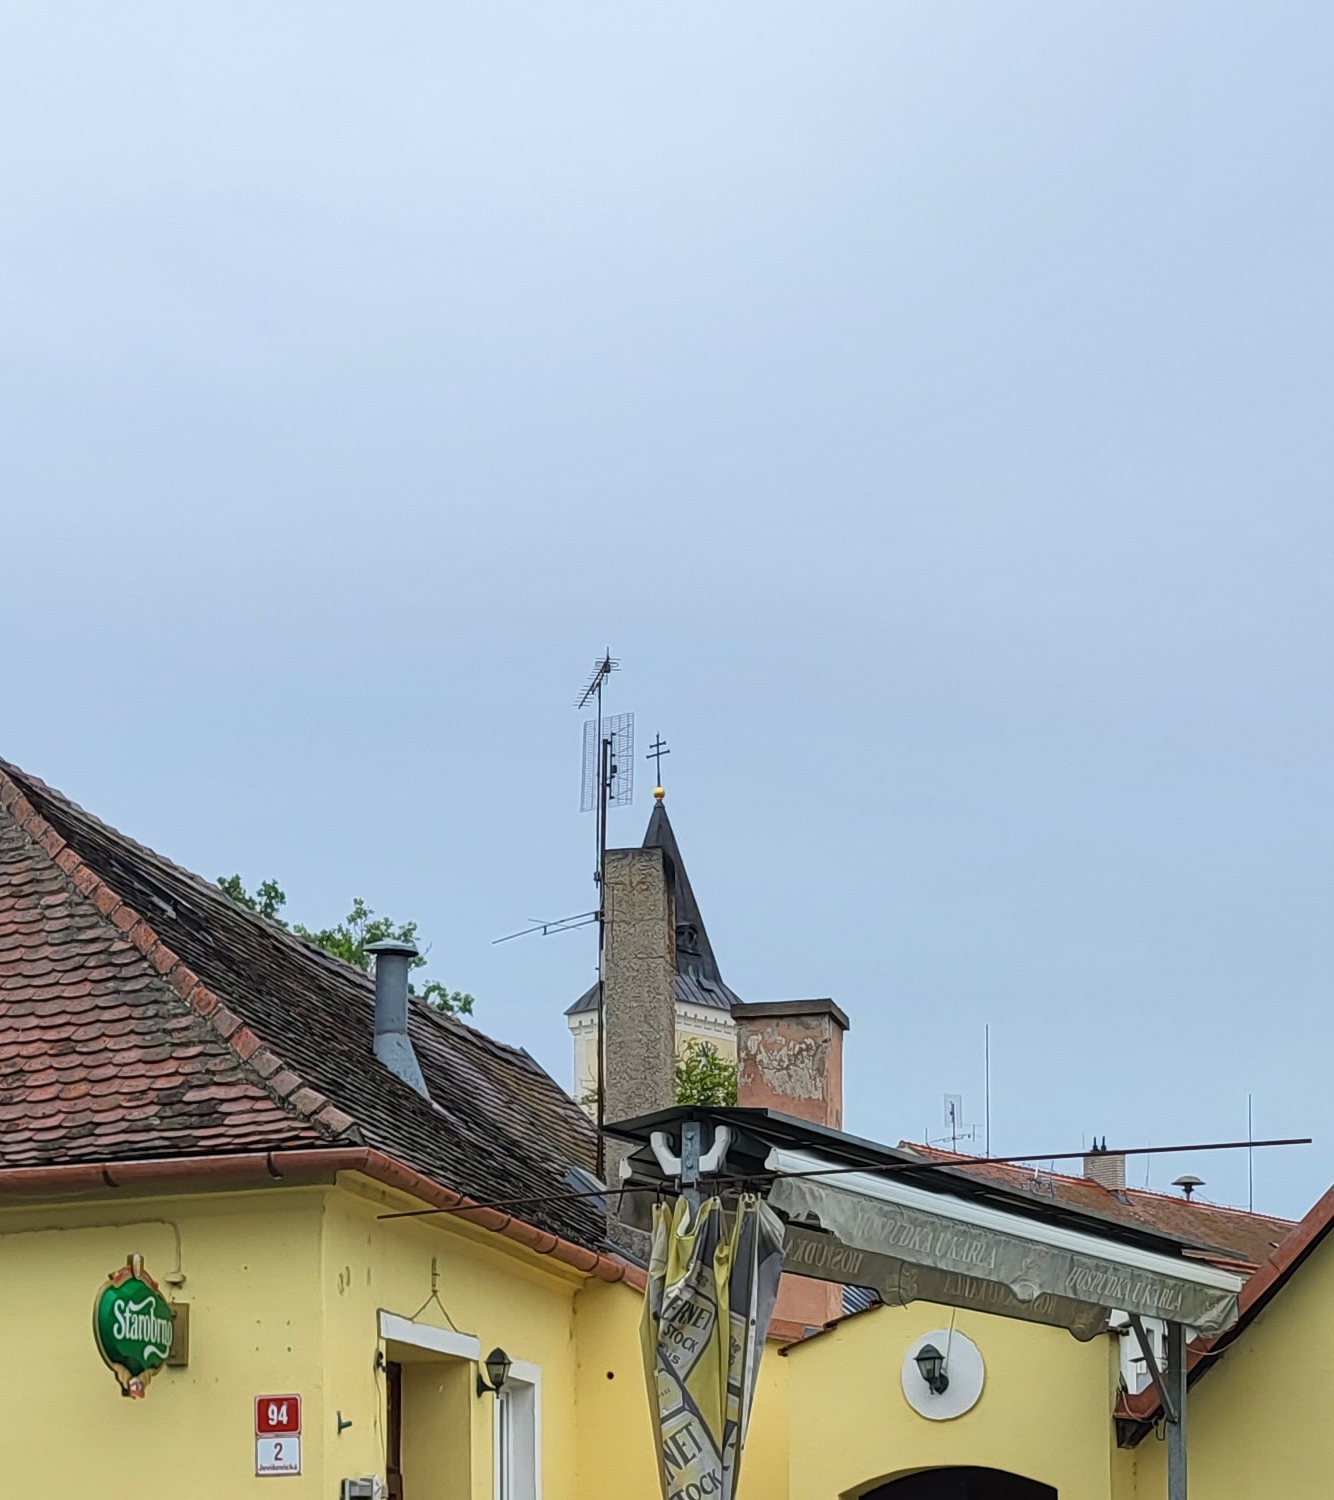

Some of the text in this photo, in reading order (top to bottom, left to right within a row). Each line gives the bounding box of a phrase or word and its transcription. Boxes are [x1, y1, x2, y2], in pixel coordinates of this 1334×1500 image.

[948, 1236, 998, 1269] KARLA
[1143, 1285, 1182, 1311] KARLA
[113, 1296, 173, 1361] Starobrno
[662, 1323, 699, 1353] STOCK
[268, 1402, 288, 1425] 94
[273, 1442, 284, 1461] 2
